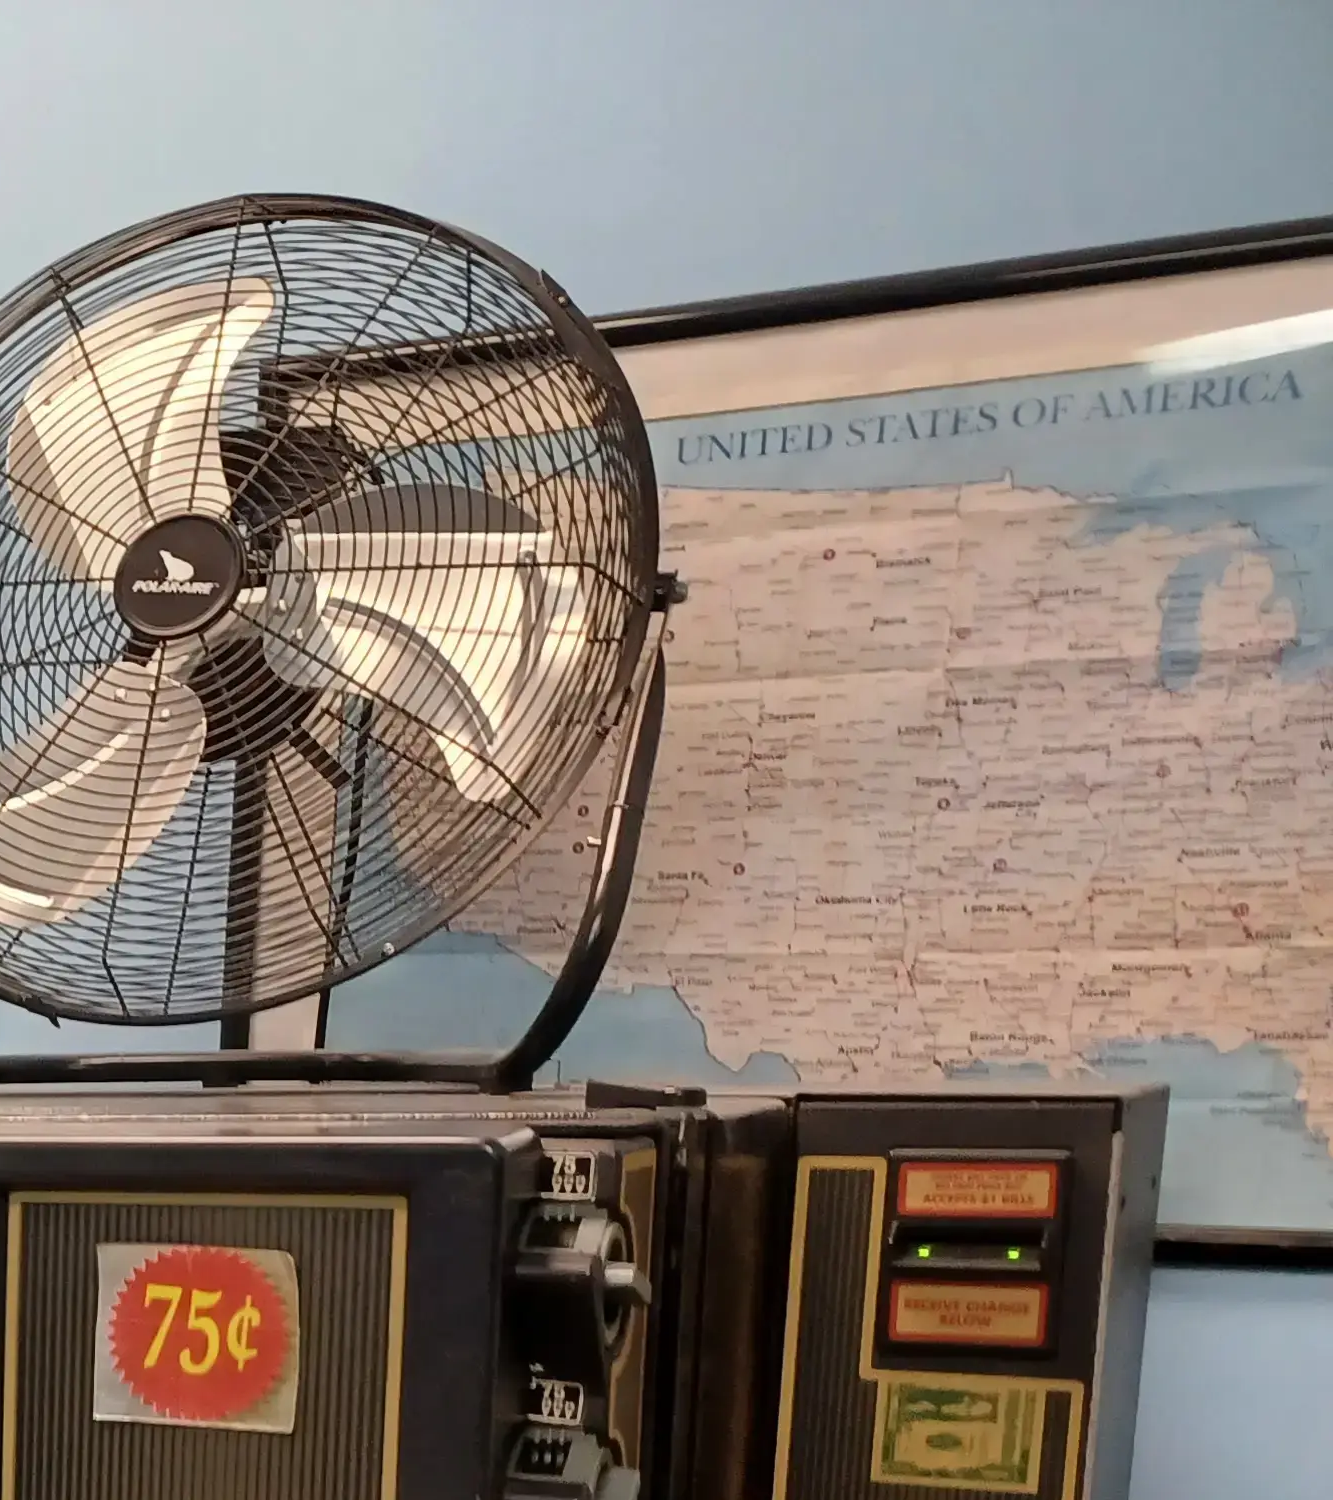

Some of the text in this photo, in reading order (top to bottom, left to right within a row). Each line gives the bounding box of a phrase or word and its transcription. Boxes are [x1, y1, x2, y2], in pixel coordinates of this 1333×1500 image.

[677, 368, 1304, 466] UNITED STATES OF AMERICA
[143, 1283, 261, 1376] 75¢
